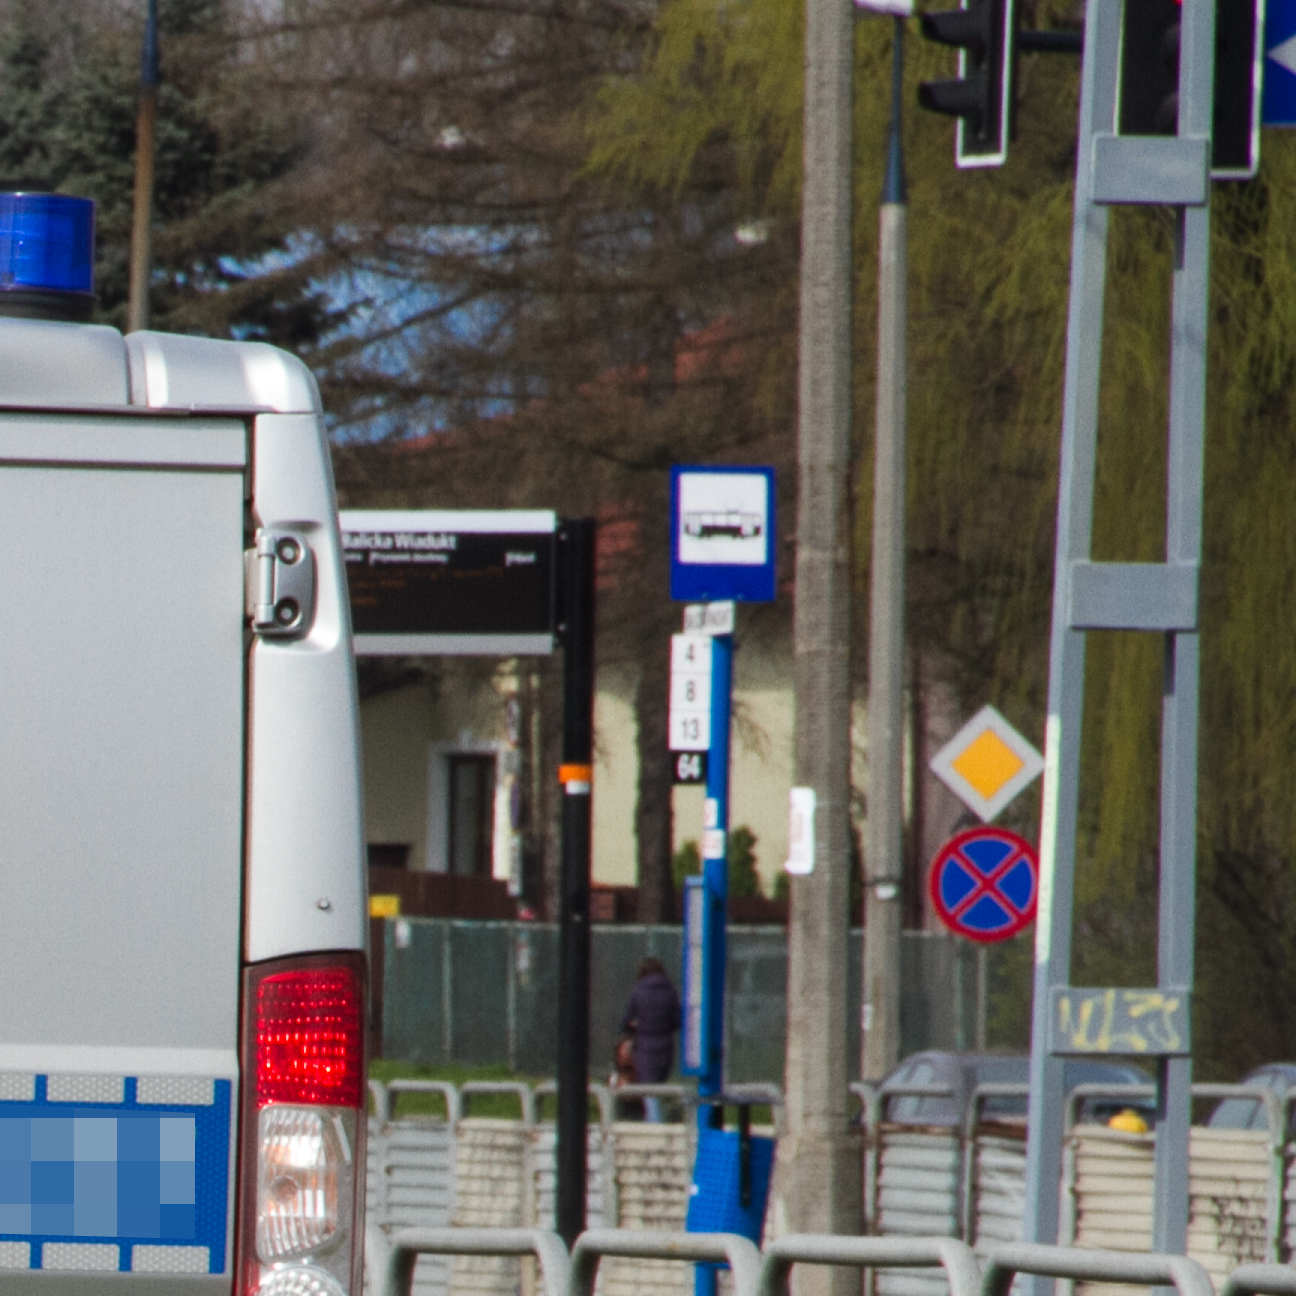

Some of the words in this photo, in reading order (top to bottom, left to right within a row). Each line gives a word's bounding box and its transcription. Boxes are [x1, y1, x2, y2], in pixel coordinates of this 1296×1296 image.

[685, 642, 695, 663] 4
[685, 680, 696, 703] 8
[680, 718, 700, 741] 13
[677, 752, 702, 780] 64
